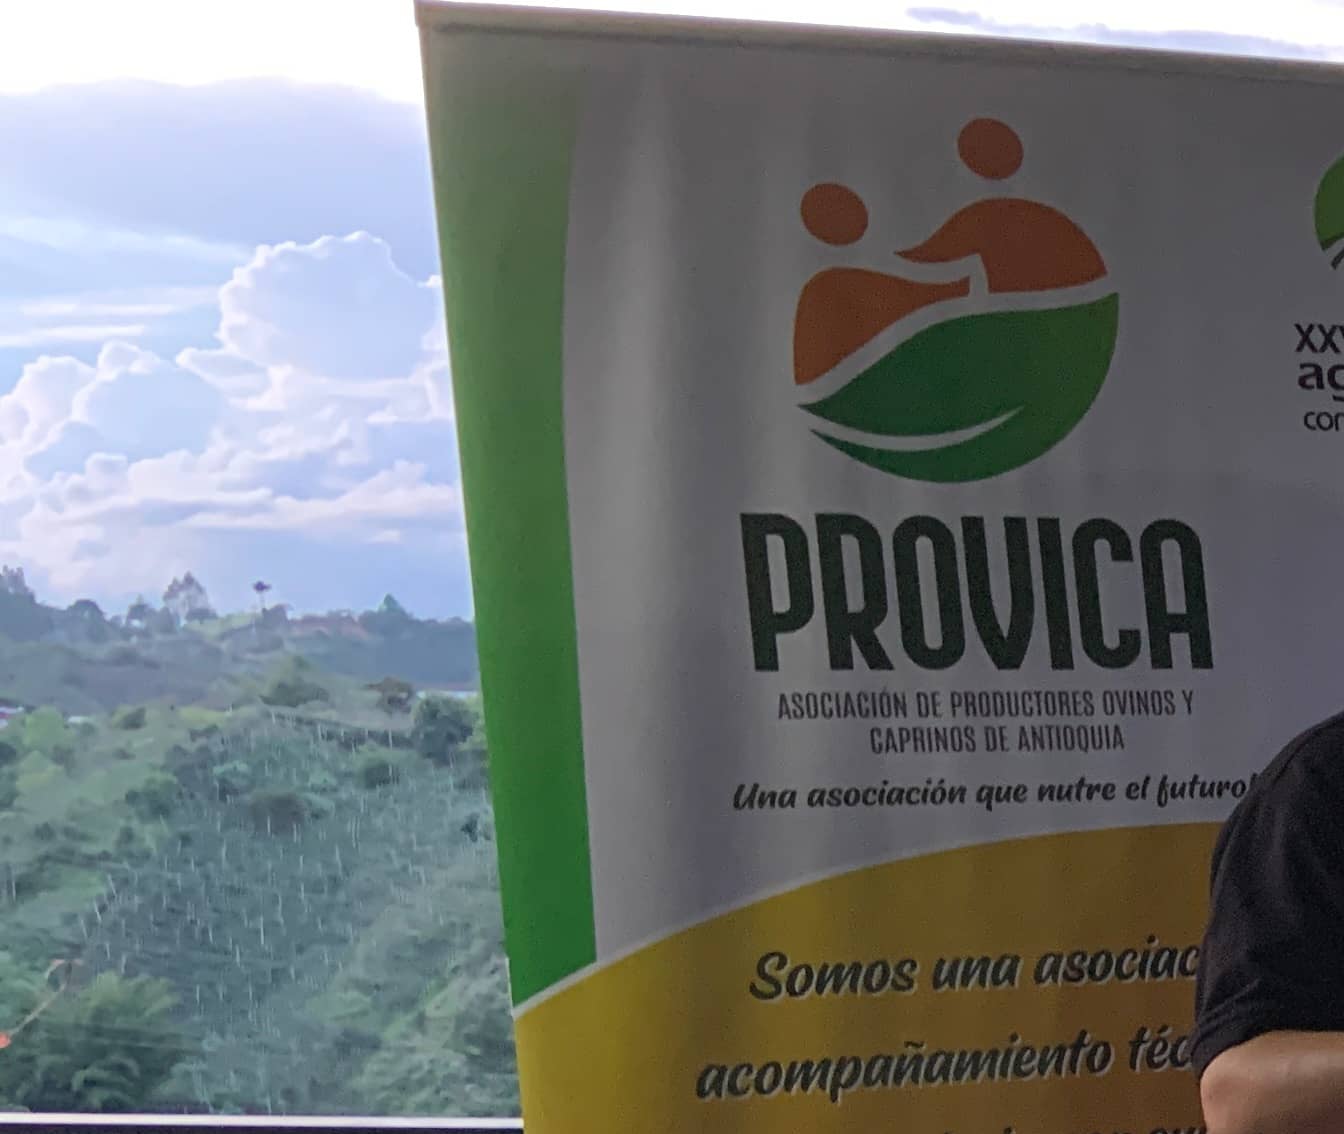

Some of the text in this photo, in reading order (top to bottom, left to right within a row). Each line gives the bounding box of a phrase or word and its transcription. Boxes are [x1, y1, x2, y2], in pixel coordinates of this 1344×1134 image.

[740, 512, 1214, 672] PROVICA
[778, 687, 1194, 721] ASOCIACIÓN DE PRODUCTORES OVINOS Y
[869, 724, 1125, 754] CAPRINOS DE ANTIOQUIA
[732, 782, 797, 811] Una
[808, 777, 967, 809] asociación
[975, 783, 1028, 813] que
[1038, 777, 1116, 803] nutre
[1125, 774, 1151, 801] el
[749, 935, 1199, 1002] Somos una asociac
[696, 1029, 1115, 1102] acompañamiento
